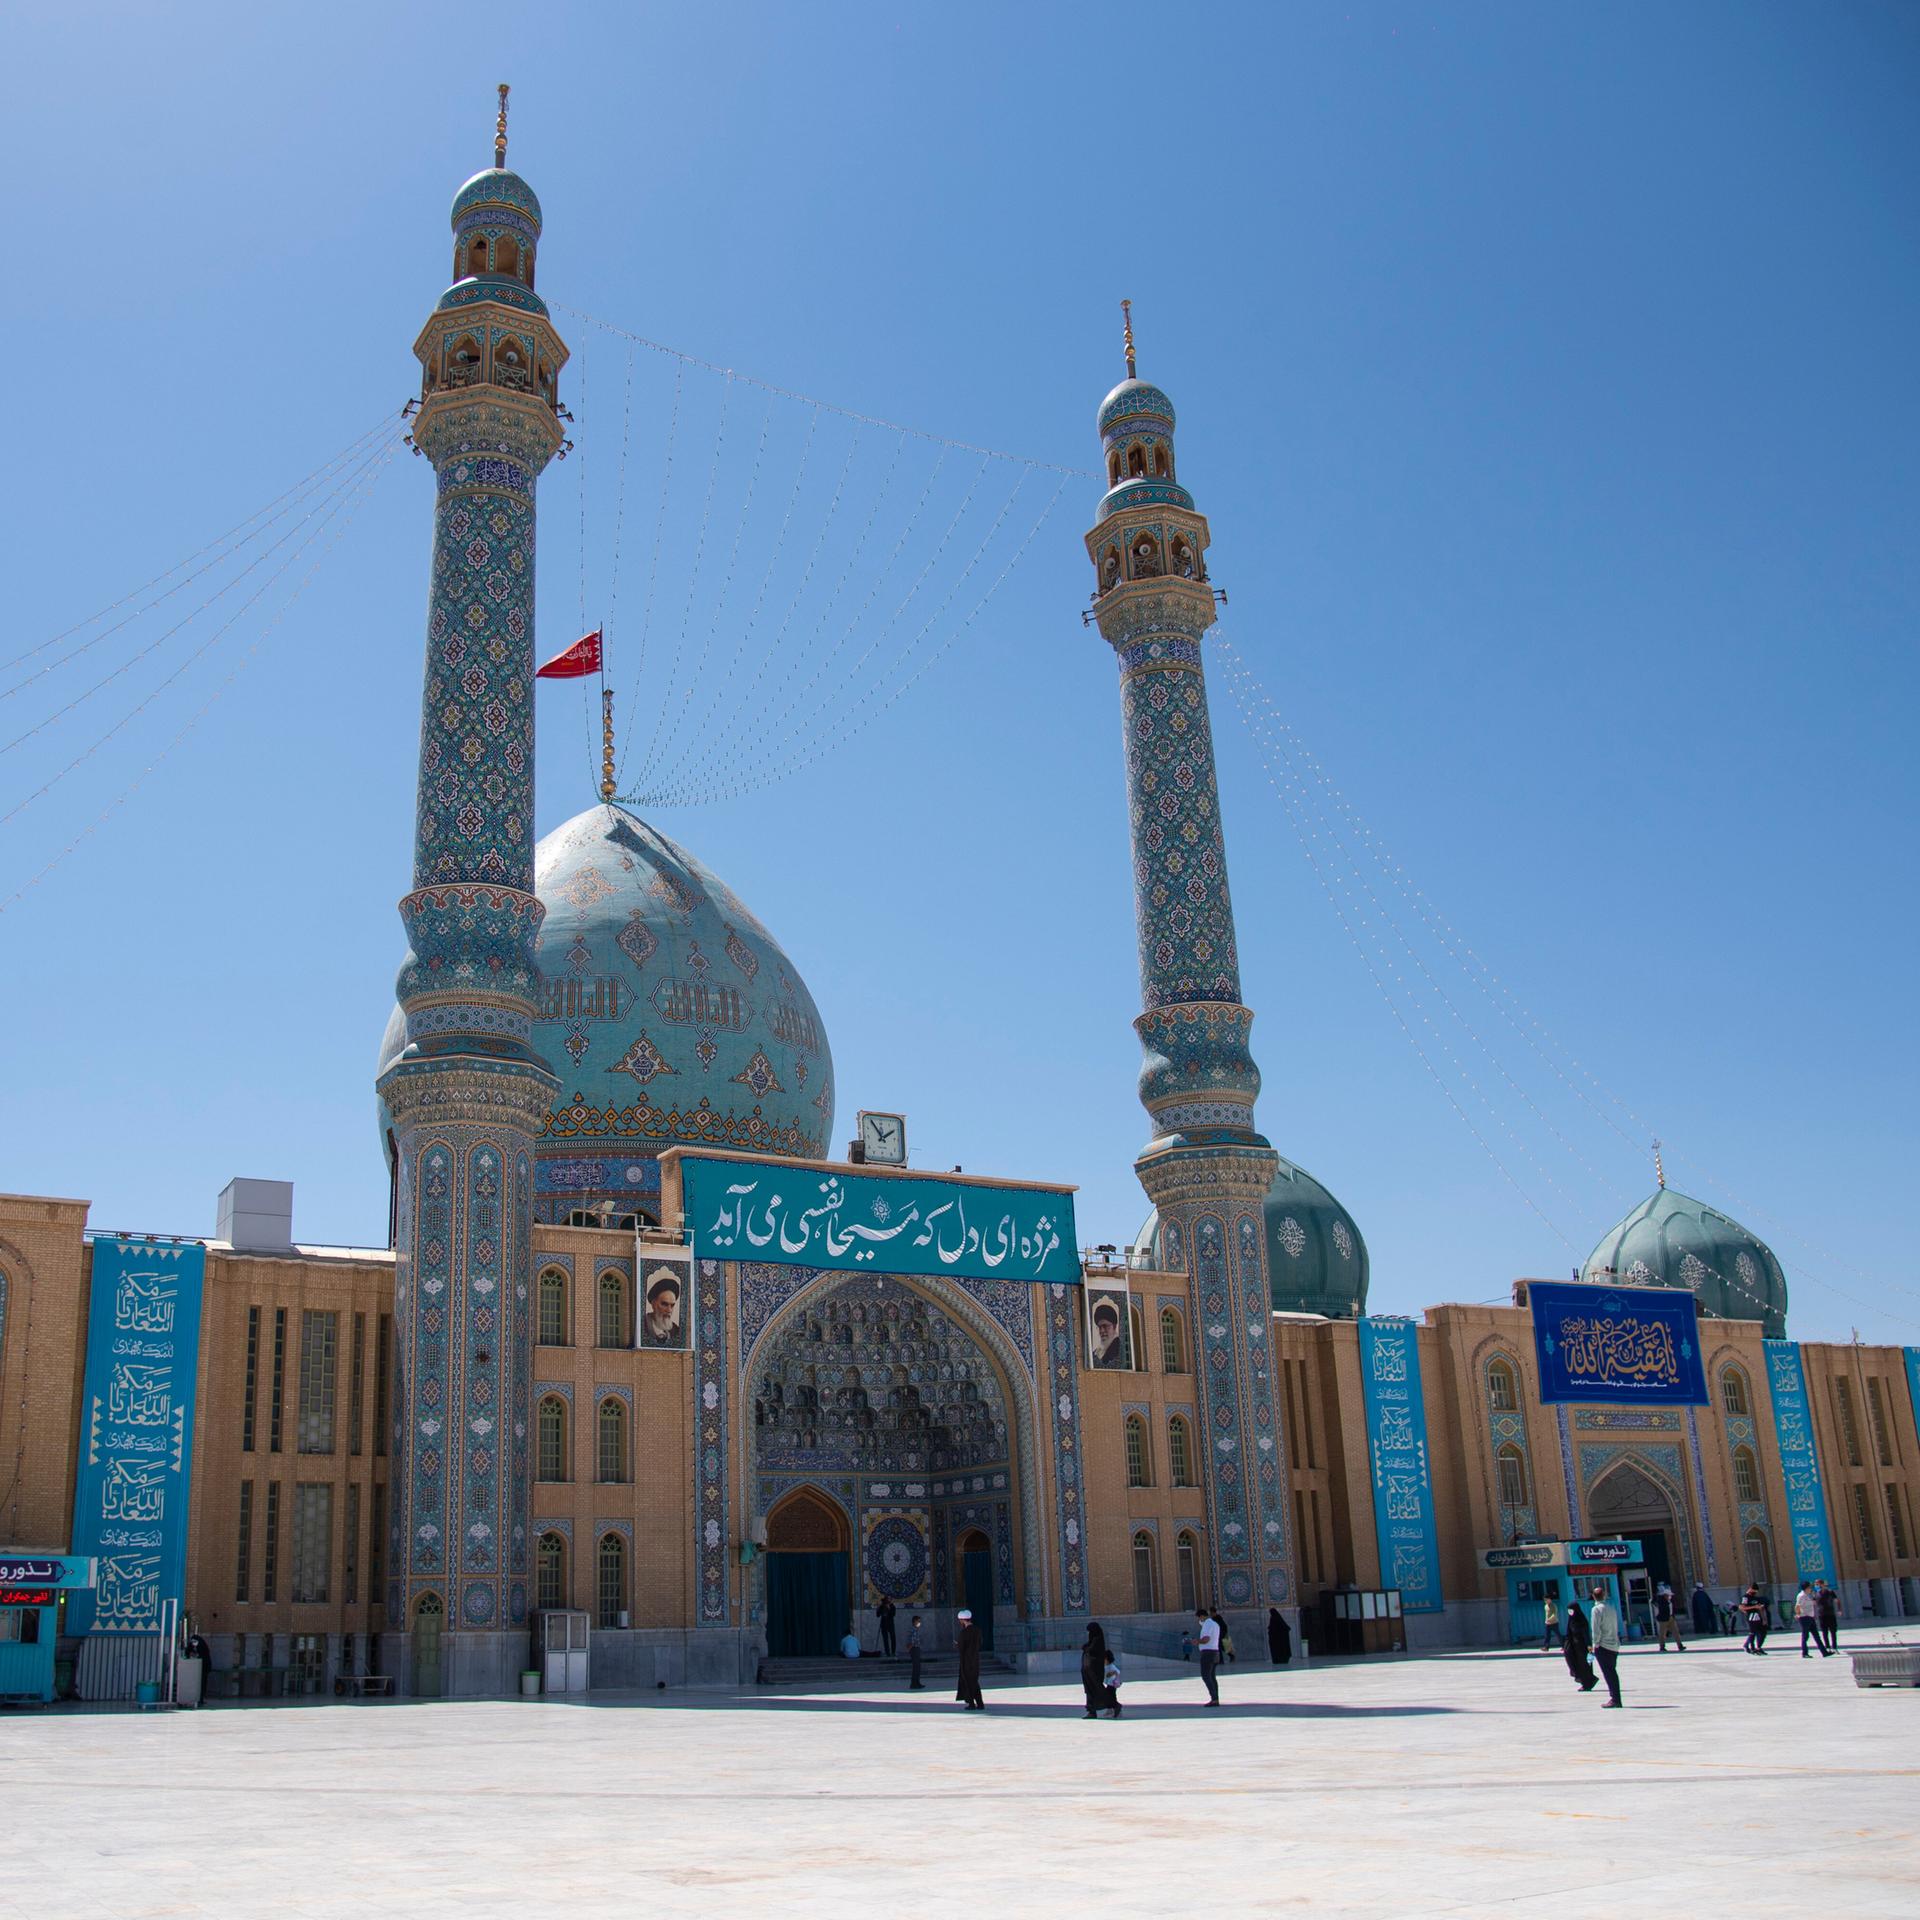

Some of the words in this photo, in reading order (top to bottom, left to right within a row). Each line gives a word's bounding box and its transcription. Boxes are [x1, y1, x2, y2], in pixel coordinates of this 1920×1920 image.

[707, 1181, 758, 1247] آید
[746, 1194, 782, 1247] می
[912, 1201, 954, 1246] که
[938, 1194, 979, 1264] دل
[982, 1214, 1015, 1267] ای
[1022, 1214, 1060, 1275] مژده
[8, 1562, 52, 1580] نذور
